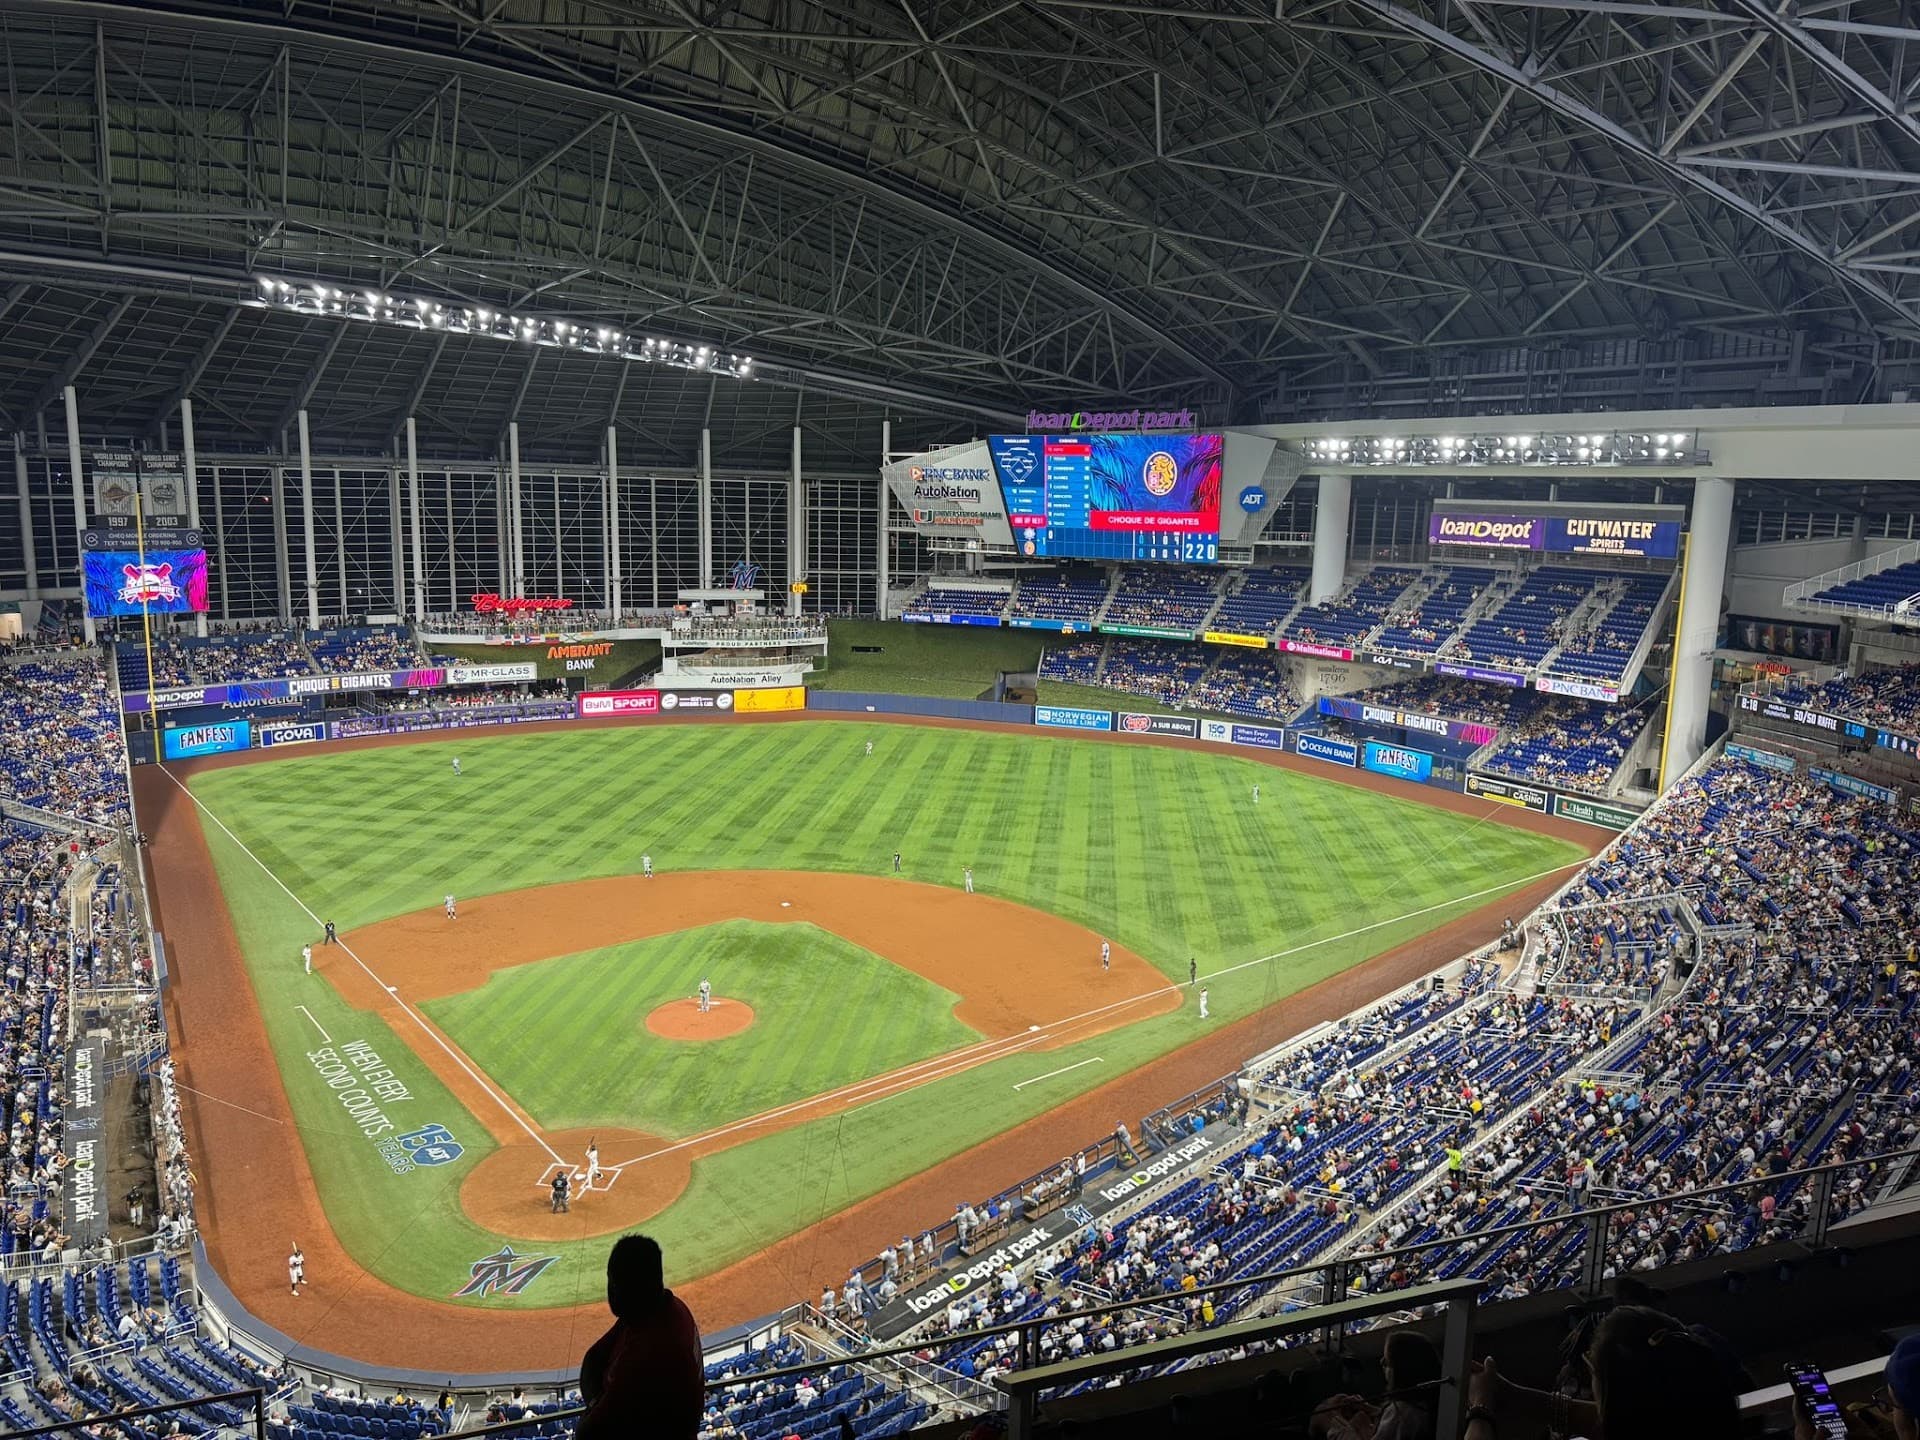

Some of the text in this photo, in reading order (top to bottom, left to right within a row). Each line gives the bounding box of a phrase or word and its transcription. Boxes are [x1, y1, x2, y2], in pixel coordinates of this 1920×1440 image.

[1029, 408, 1194, 431] loanDepot park
[914, 486, 978, 498] AutoNation
[1242, 494, 1263, 505] ADT
[108, 517, 128, 527] 1997
[156, 517, 178, 527] 2003
[1108, 516, 1199, 525] CHOQUE DE GIGANTES
[1440, 518, 1532, 541] loanDepot
[1567, 519, 1651, 539] CUTWATER
[1590, 539, 1625, 548] SPIRITS
[471, 593, 573, 611] Budweiser
[547, 642, 614, 659] AMERANT
[1295, 643, 1343, 658] Multinational
[471, 666, 530, 677] MR-GLASS
[566, 658, 595, 671] BANK
[289, 678, 330, 695] CHOQUE
[341, 674, 392, 688] GIGANTES
[710, 675, 781, 685] AutoNation Alley
[1319, 673, 1346, 684] 1796
[1552, 682, 1578, 694] PNC
[613, 697, 655, 708] SPORT
[1051, 711, 1109, 721] NORWEGIAN
[1051, 717, 1079, 725] CRUISE
[1362, 706, 1395, 724] CHOQUE
[1404, 714, 1448, 736] GIGANTES
[1817, 715, 1837, 731] RAFFLE
[1171, 723, 1192, 731] ABOVE
[1237, 728, 1269, 738] When Every
[179, 727, 236, 750] FANFEST
[274, 728, 314, 742] GOYA
[1236, 734, 1255, 742] Second
[1256, 736, 1279, 745] Counts.
[1308, 742, 1354, 760] OCEAN BANK
[1375, 748, 1420, 773] FANFEST
[1513, 791, 1543, 805] CASINO
[71, 1047, 97, 1109] loanDepot park
[340, 1039, 414, 1104] WHEN EVERY
[306, 1047, 394, 1138] SECOND COUNTS.
[374, 1136, 415, 1175] YEARS
[425, 1147, 451, 1161] ADT
[1100, 1134, 1214, 1203] loanDepot park
[69, 1139, 100, 1223] loanDepot park
[906, 1225, 1052, 1315] loanDepot park
